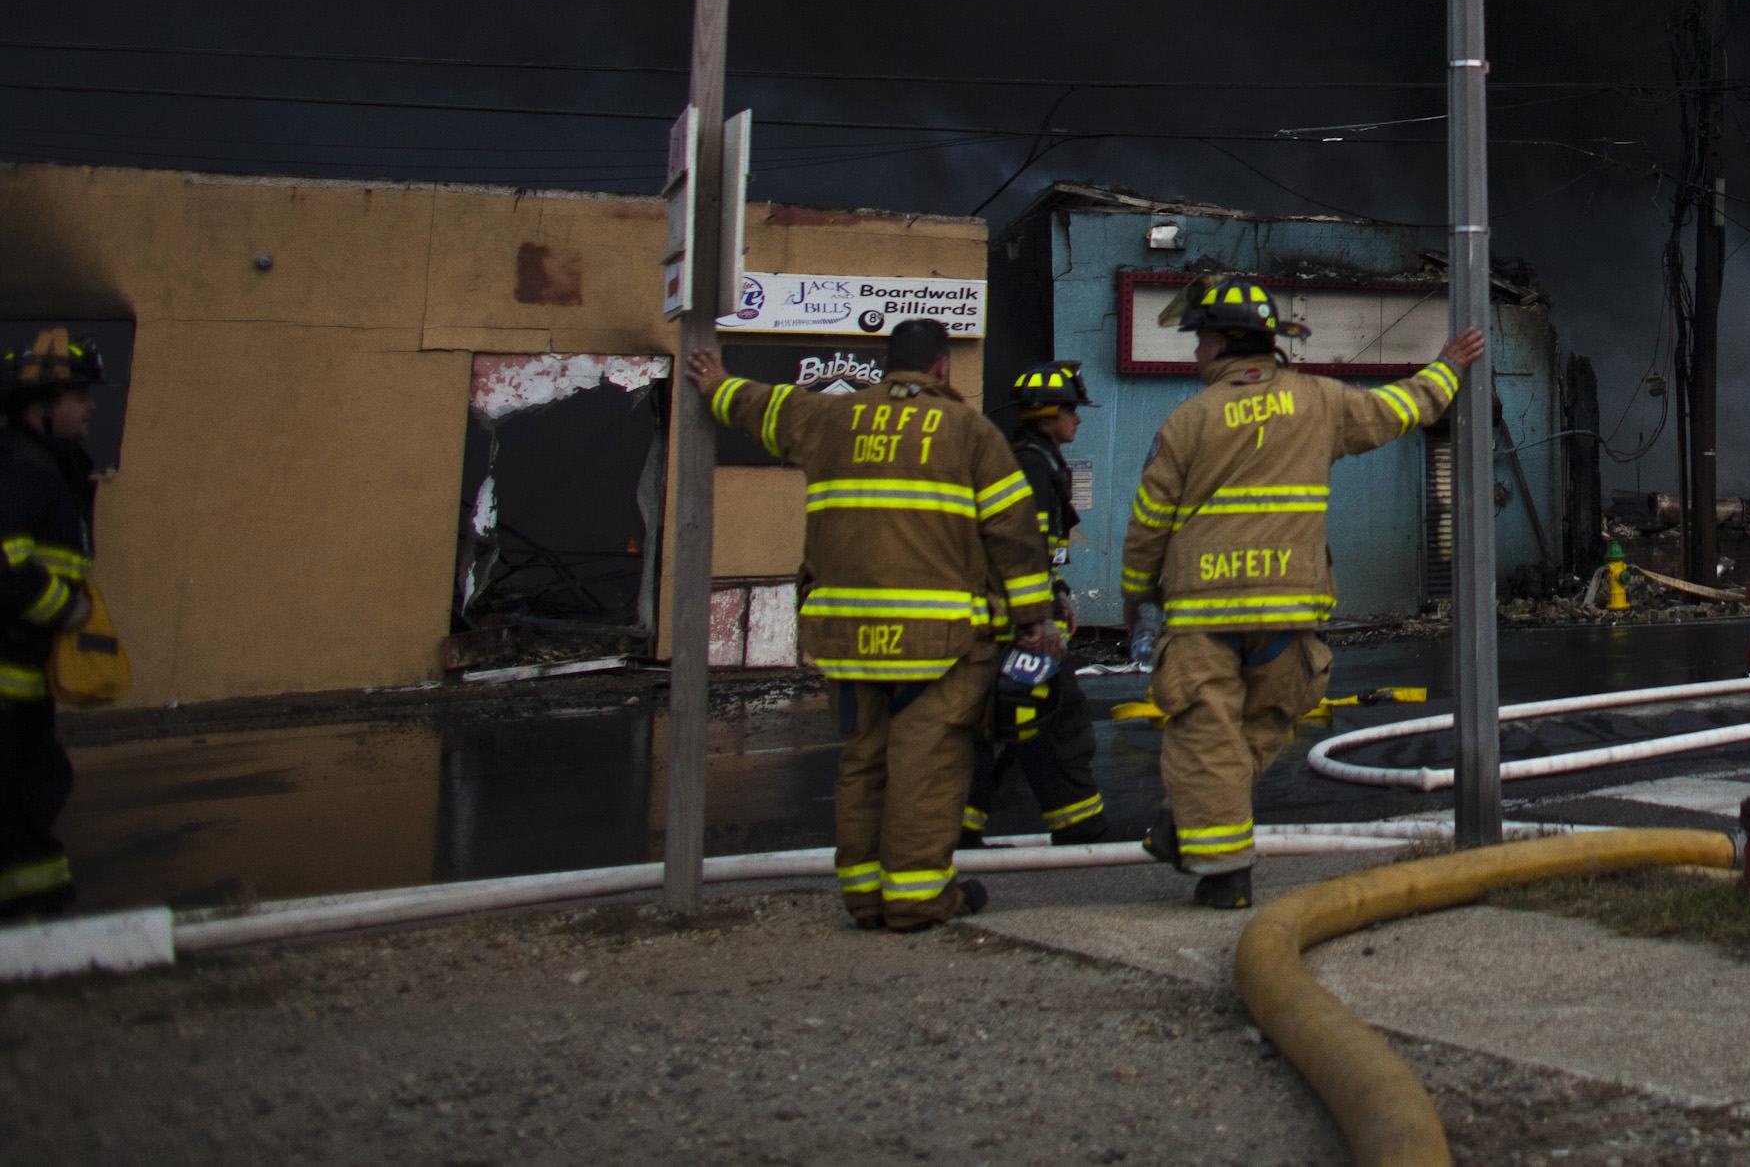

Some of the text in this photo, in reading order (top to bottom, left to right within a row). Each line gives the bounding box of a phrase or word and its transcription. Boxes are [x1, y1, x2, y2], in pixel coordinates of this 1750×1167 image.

[792, 281, 852, 305] JACK
[860, 284, 978, 300] Boardwalk
[884, 301, 978, 316] Billiards
[796, 352, 883, 386] Bubba's
[1224, 390, 1295, 428] OCEAN
[853, 435, 932, 464] DIST 1
[1256, 425, 1265, 449] 1
[1200, 548, 1292, 580] SAFETY
[857, 624, 904, 655] CIRZ
